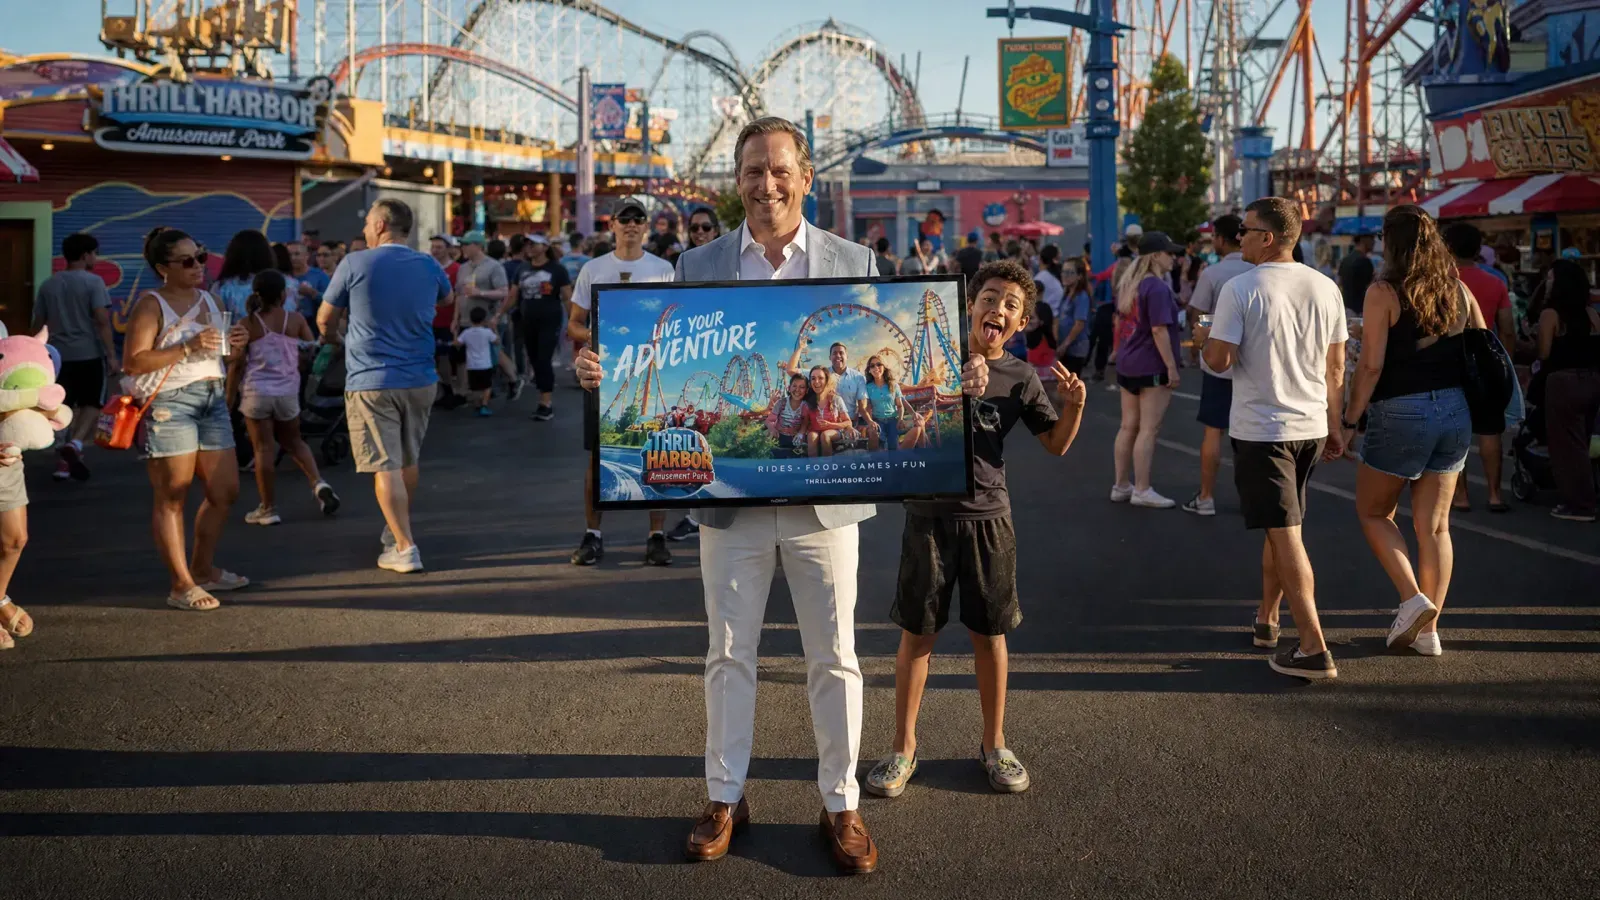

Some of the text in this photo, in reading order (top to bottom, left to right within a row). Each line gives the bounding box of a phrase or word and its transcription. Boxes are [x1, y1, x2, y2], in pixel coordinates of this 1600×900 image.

[101, 83, 316, 127] THRILL HARBOR
[126, 122, 286, 149] Amusement Park
[652, 310, 724, 340] LIVE YOUR
[612, 321, 757, 382] ADVENTURE
[650, 431, 703, 452] THRILL
[646, 450, 713, 470] HARBOR
[757, 464, 793, 473] RIDES
[805, 463, 839, 471] FOOD
[850, 461, 891, 470] GAMES
[692, 472, 708, 480] Park
[805, 476, 883, 485] THRILLHARBOR.COM
